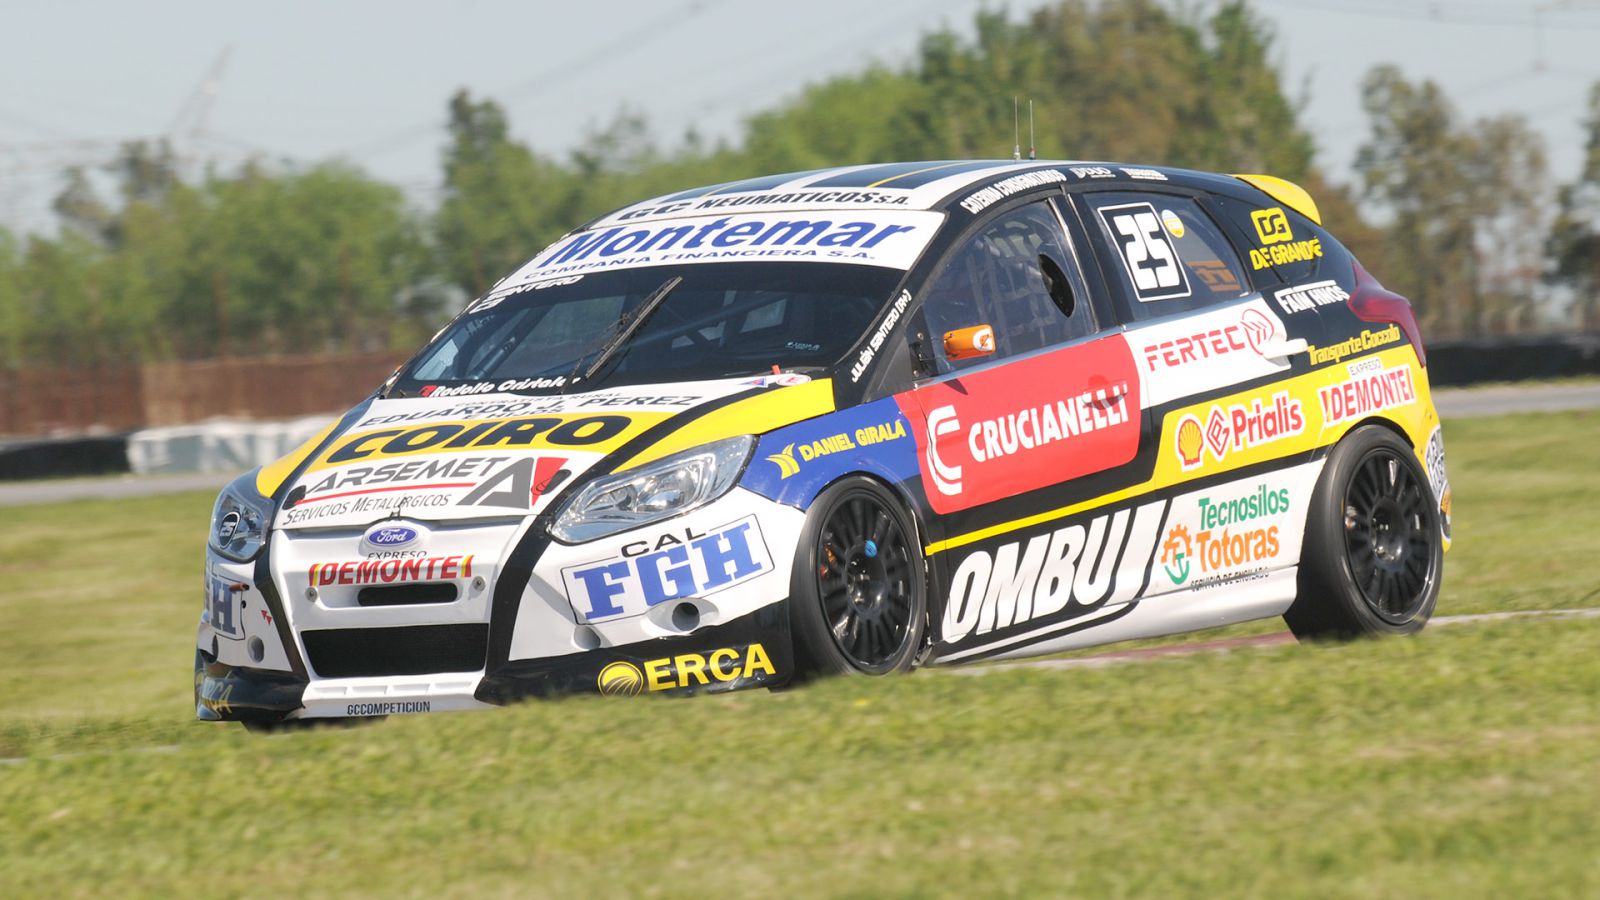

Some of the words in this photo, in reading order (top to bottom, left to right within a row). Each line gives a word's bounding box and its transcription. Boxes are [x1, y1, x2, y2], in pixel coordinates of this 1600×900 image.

[618, 202, 692, 221] GC
[695, 192, 880, 210] NEUMATICOS
[537, 216, 917, 268] Montemar
[661, 249, 817, 261] FINANCIERA
[827, 249, 876, 260] S.A.
[1113, 212, 1180, 290] 25
[1249, 247, 1273, 270] DE
[1270, 238, 1323, 265] GRANDE
[870, 308, 900, 352] SANTERO
[1144, 325, 1245, 371] FERTEC
[1349, 358, 1381, 376] EXPRESO
[430, 382, 495, 397] Rodolfo
[360, 402, 531, 426] EDUARDO
[577, 395, 704, 407] PEREZ
[968, 382, 1129, 463] CRUCIANELLI
[1231, 396, 1302, 447] Prialis
[326, 415, 632, 462] COIRO
[798, 432, 856, 461] DANIEL
[303, 457, 508, 494] ARSEMET
[282, 504, 348, 526] SERVICIOS
[1198, 484, 1290, 531] Tecnosilos
[219, 521, 237, 537] 25
[376, 528, 409, 544] Ford
[621, 528, 706, 557] CAL
[366, 551, 427, 560] EXPRESO
[1195, 525, 1280, 572] Totoras
[318, 556, 459, 586] DEMONTE
[573, 522, 762, 620] FGH
[941, 507, 1132, 644] OMBU
[644, 643, 776, 691] ERCA
